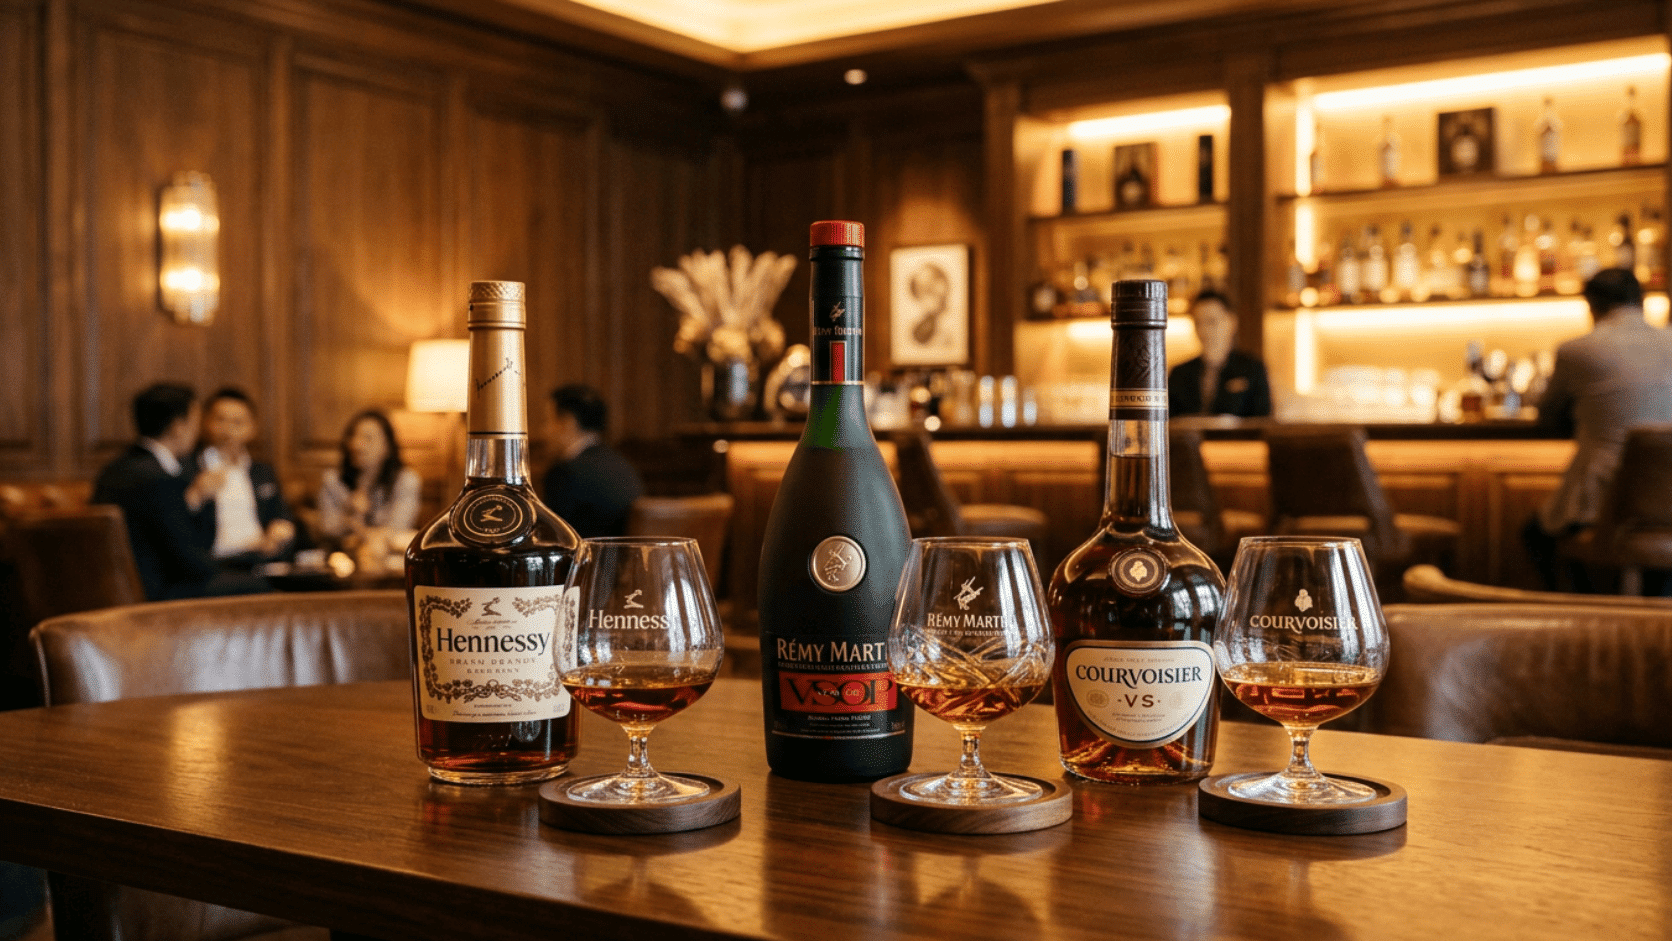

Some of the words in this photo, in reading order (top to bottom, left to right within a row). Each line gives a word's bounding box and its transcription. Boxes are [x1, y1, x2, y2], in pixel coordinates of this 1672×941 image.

[588, 609, 670, 630] Henness
[927, 612, 960, 628] RÉMY
[963, 613, 1006, 629] MARTI
[436, 627, 551, 656] Hennessy
[777, 638, 824, 662] RÉMY
[830, 641, 887, 662] MART
[1075, 664, 1202, 689] COURVOISIER
[785, 678, 893, 706] VSOP
[1124, 694, 1154, 708] VS
